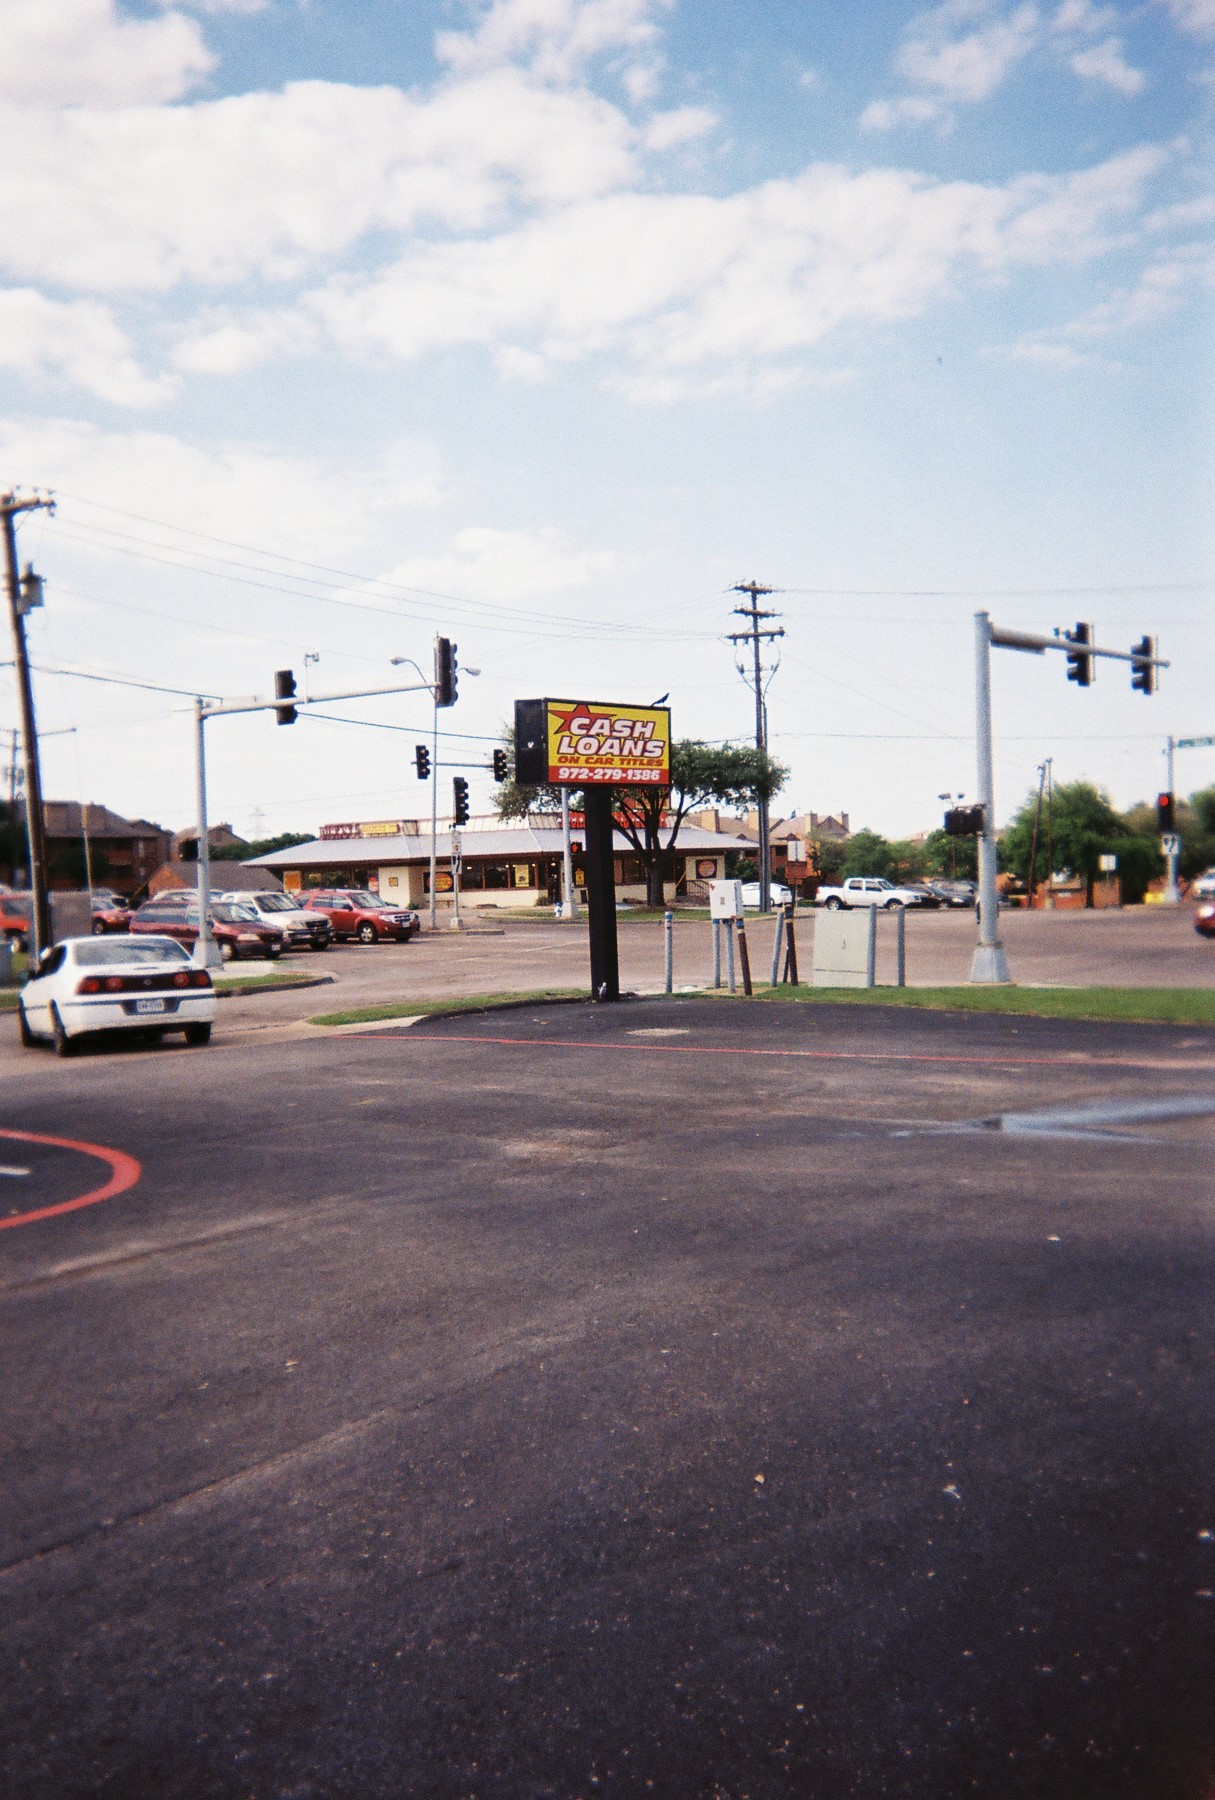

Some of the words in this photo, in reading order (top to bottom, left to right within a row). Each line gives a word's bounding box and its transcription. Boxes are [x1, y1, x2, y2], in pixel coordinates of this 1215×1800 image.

[569, 717, 655, 738] CASH
[558, 736, 665, 757] LOANS
[557, 756, 579, 764] ON
[585, 757, 614, 765] CAR
[619, 758, 664, 766] TITLES
[558, 767, 660, 780] 972-279-1386
